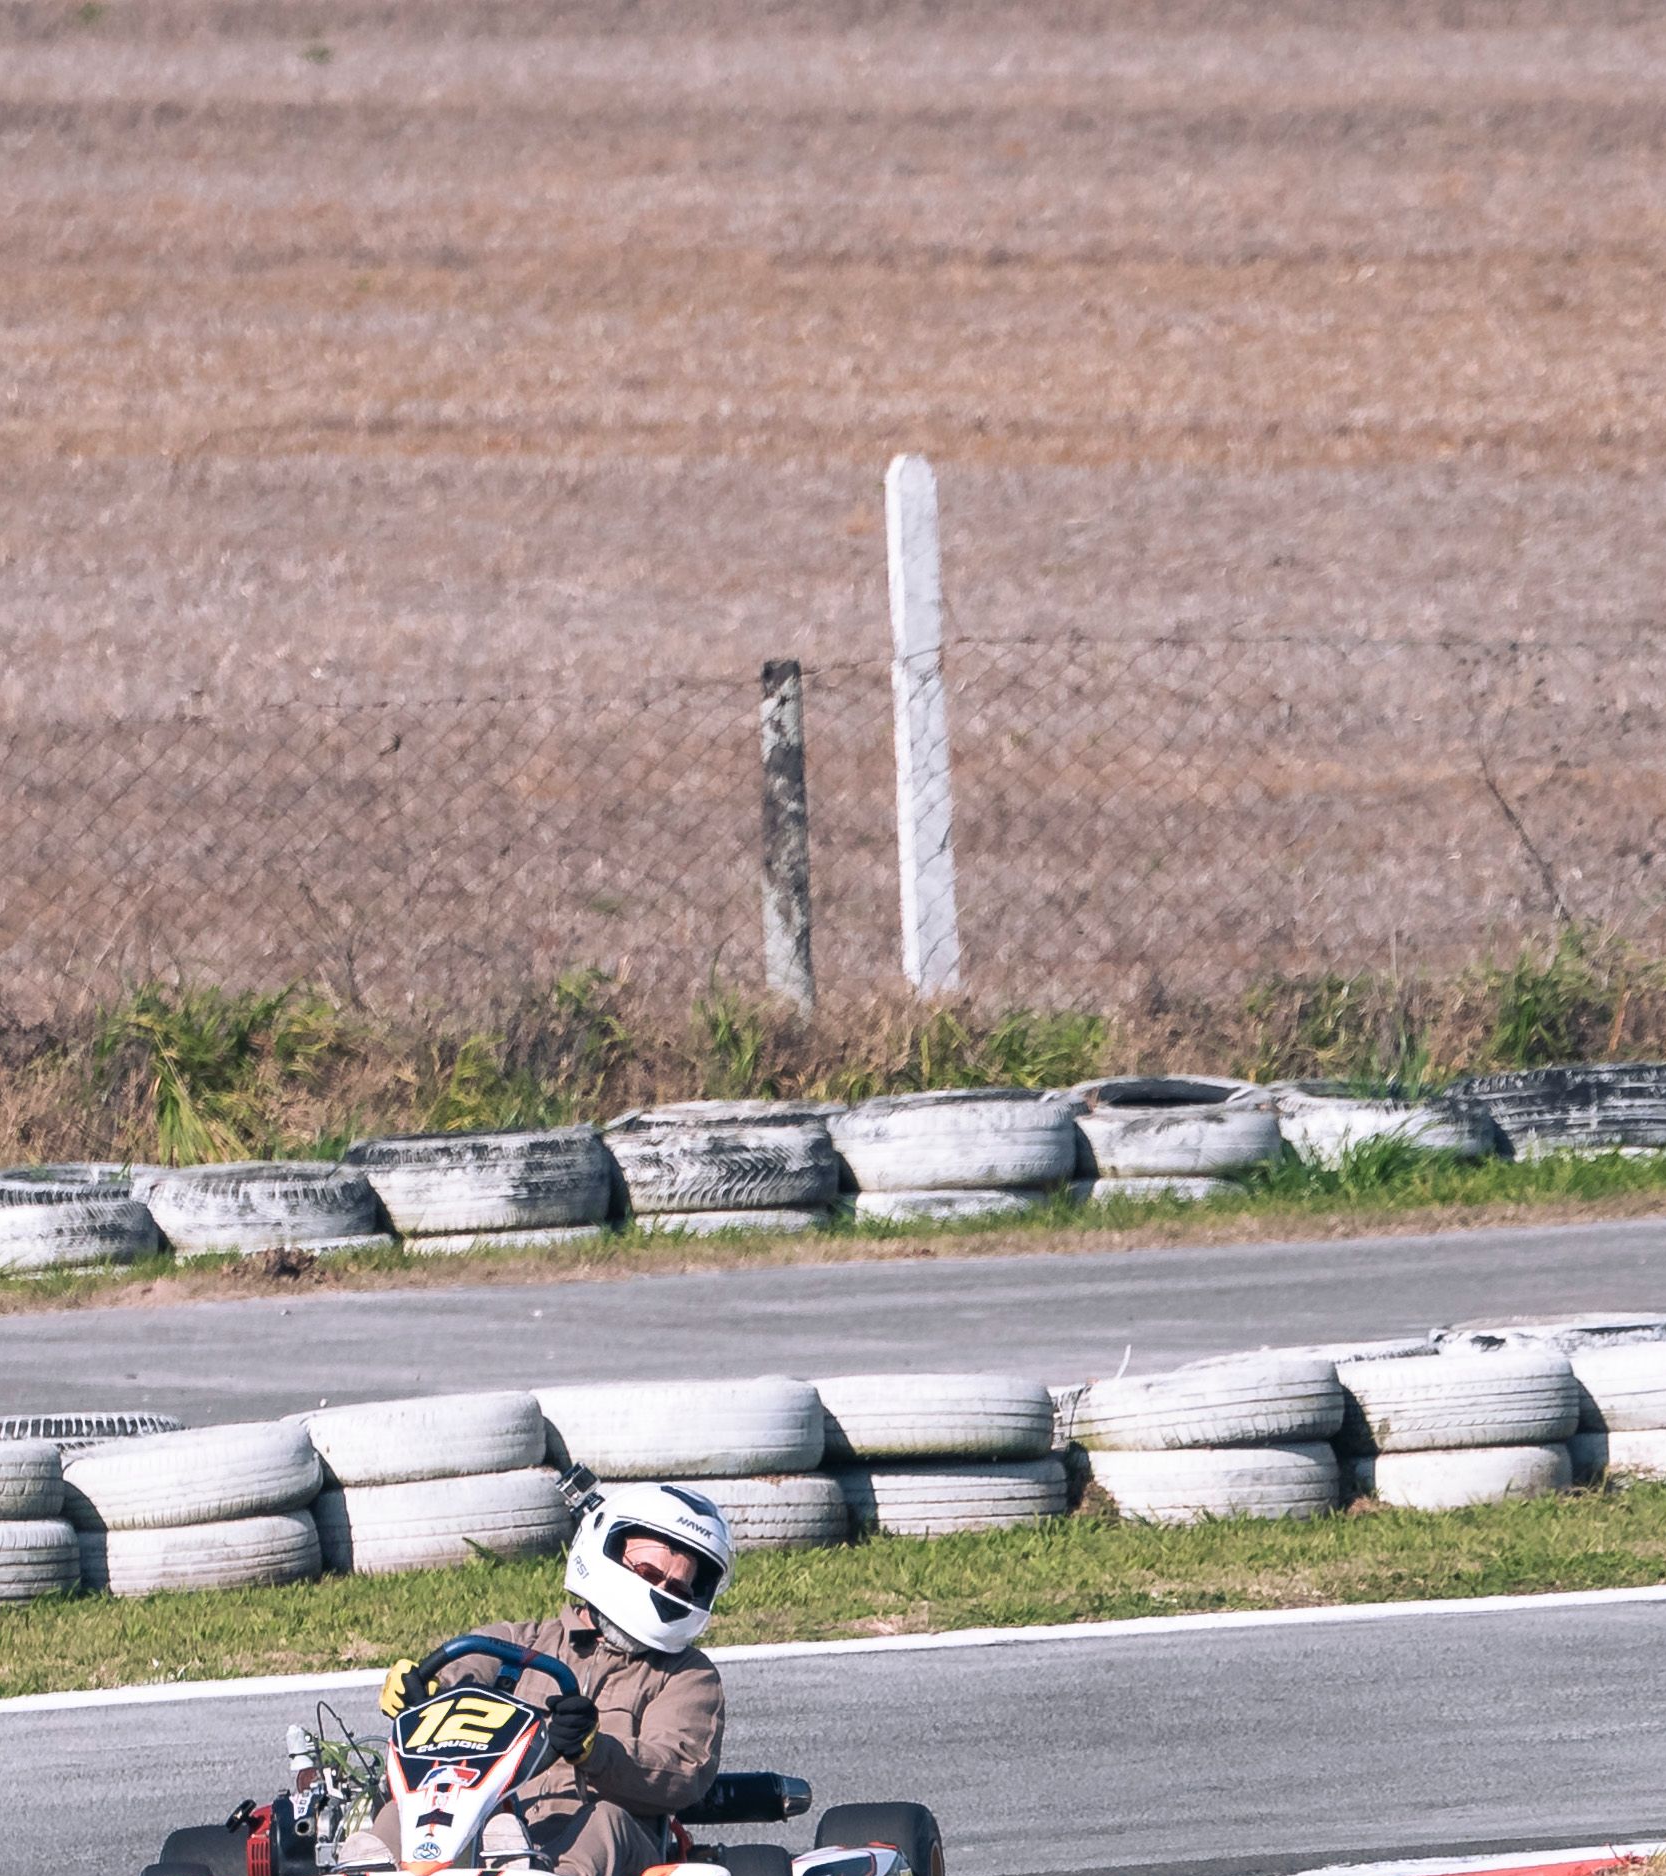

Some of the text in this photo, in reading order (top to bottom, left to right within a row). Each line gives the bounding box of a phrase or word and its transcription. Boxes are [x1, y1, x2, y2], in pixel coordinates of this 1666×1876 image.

[676, 1516, 713, 1540] HAWK
[405, 1697, 517, 1749] 12
[416, 1740, 489, 1754] CLAUDIO
